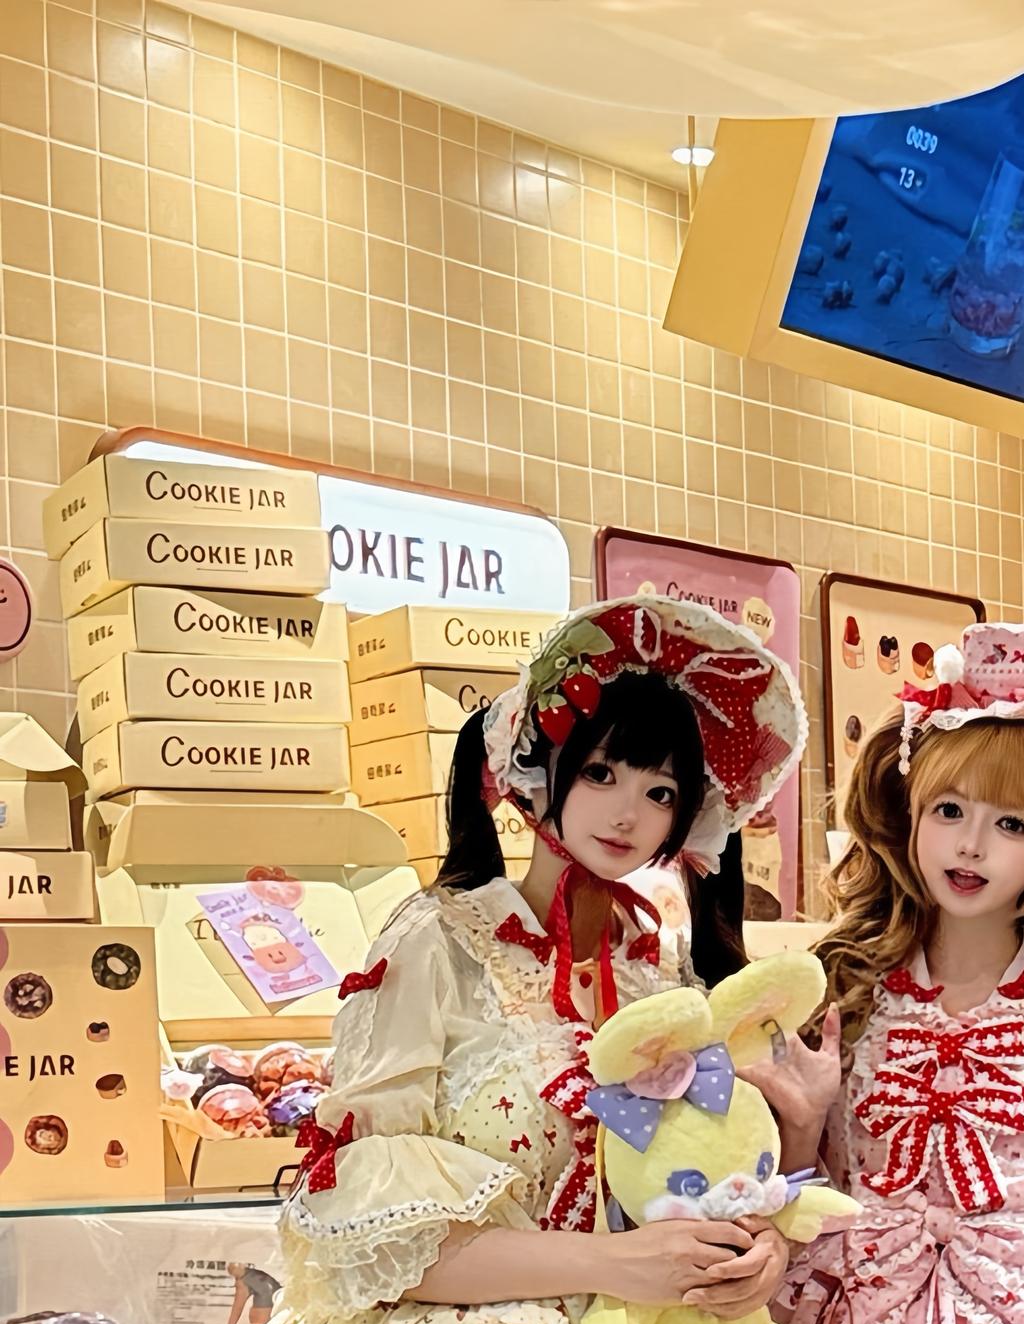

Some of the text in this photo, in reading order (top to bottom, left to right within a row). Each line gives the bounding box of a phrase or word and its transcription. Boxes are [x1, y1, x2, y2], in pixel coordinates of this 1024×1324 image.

[145, 470, 286, 510] COOKIE JAR
[146, 533, 294, 569] COOKIE JAR
[438, 541, 505, 598] JAR
[174, 602, 314, 639] COOKIE JAR
[444, 617, 531, 647] COOKIE
[746, 610, 772, 628] NEW
[166, 667, 313, 703] COOKIE JAR
[161, 736, 310, 770] COOKIE JAR
[8, 875, 52, 899] JAR
[29, 1055, 75, 1082] JAR
